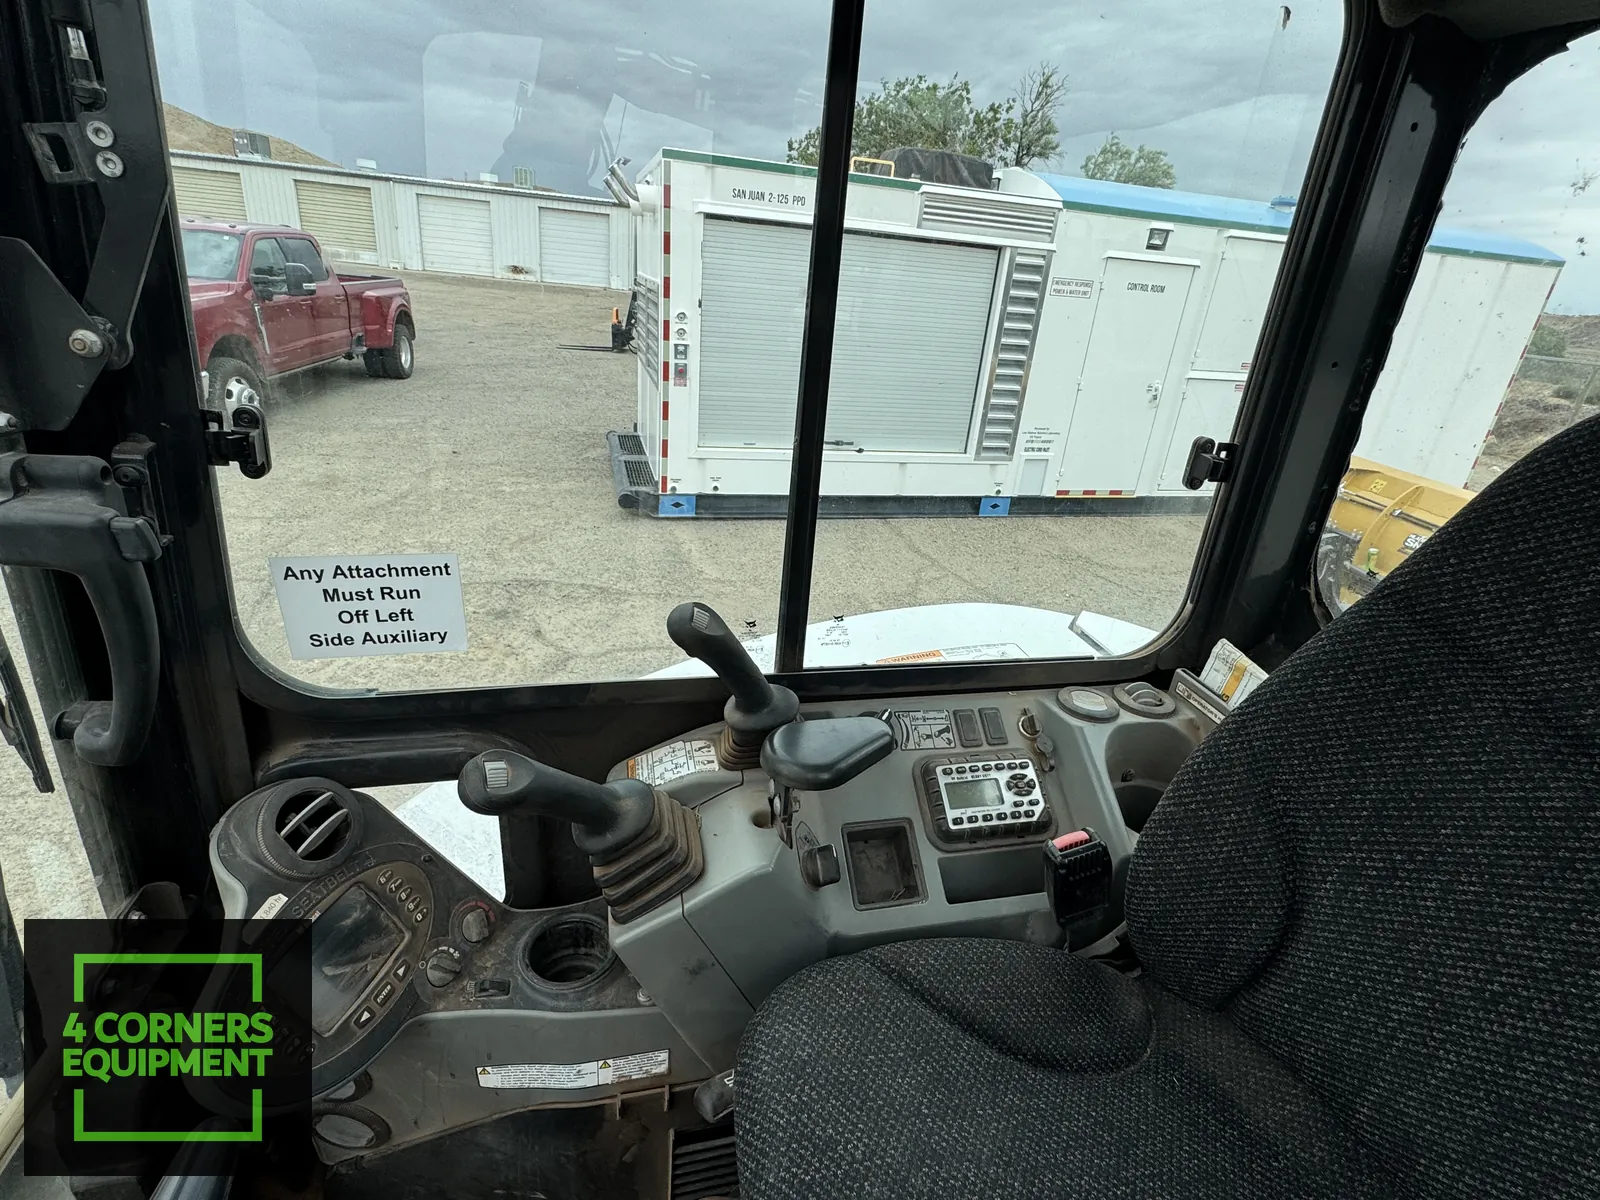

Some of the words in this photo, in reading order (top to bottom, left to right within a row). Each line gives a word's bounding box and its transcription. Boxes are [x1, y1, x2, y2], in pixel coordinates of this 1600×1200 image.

[732, 187, 746, 199] SAN
[747, 190, 765, 201] JUAN
[768, 192, 789, 204] 2-125
[1127, 282, 1149, 292] CONTROL
[1150, 284, 1165, 293] ROOM
[283, 565, 325, 584] Any
[332, 562, 452, 580] Attachment
[322, 587, 374, 603] Must
[380, 586, 421, 601] Run
[338, 609, 369, 624] Off
[375, 607, 415, 623] Left
[309, 632, 355, 648] Side
[361, 629, 448, 645] Auxiliary
[891, 651, 937, 663] WARNING
[379, 875, 386, 884] 6
[291, 860, 360, 918] SEATBELT
[390, 883, 395, 891] 7
[274, 895, 282, 903] hr
[400, 891, 407, 900] 8
[408, 902, 415, 911] 9
[416, 912, 423, 921] 0
[376, 984, 392, 1004] ENTER
